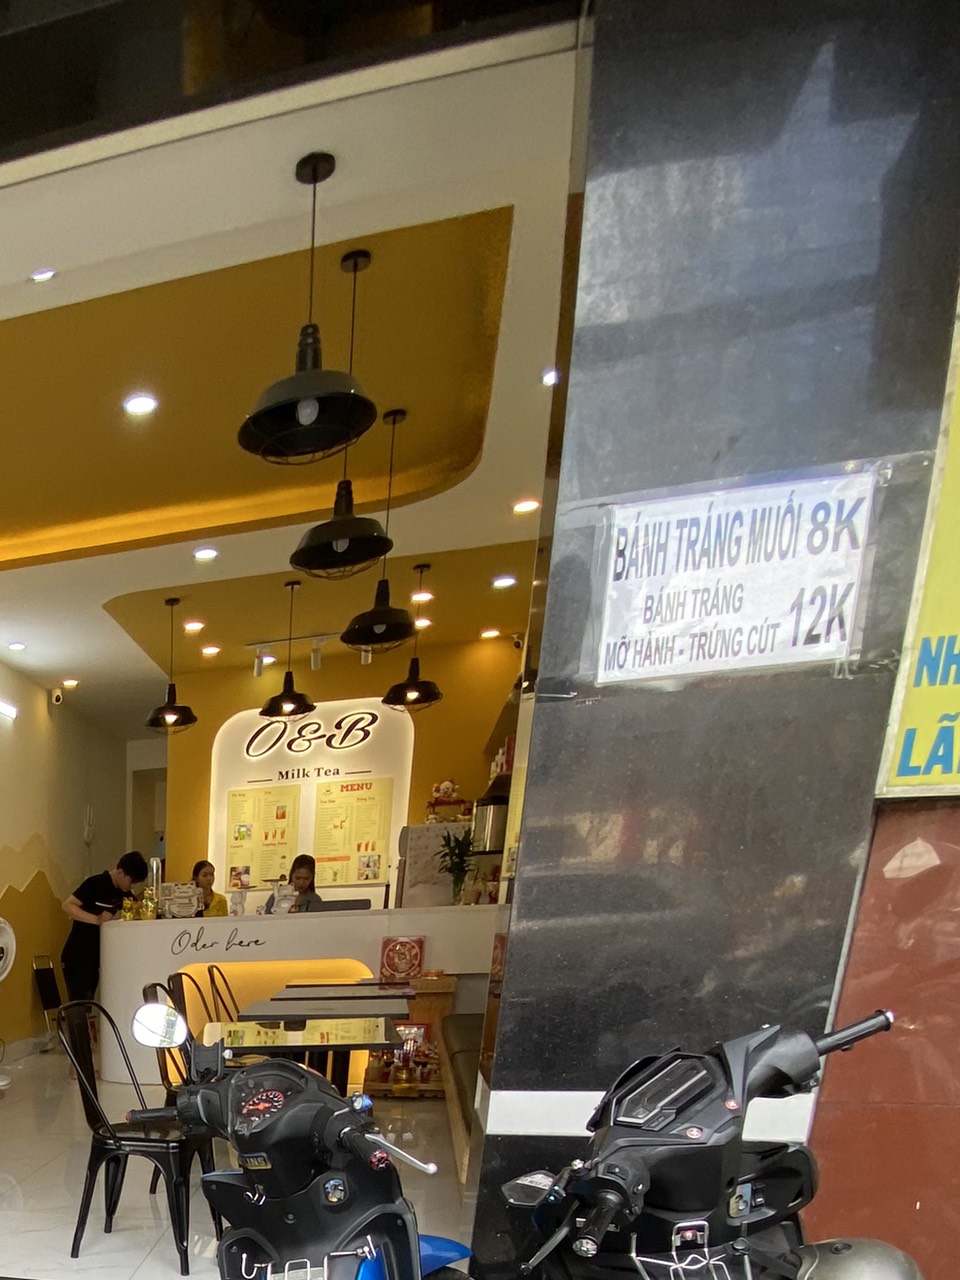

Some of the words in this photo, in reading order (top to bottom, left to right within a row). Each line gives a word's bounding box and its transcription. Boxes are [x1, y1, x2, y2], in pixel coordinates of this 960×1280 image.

[612, 512, 671, 581] BÁNH
[675, 502, 744, 573] TRÁNG
[746, 490, 803, 565] MUỐI
[807, 496, 866, 555] 8K
[643, 586, 688, 624] BÁNH
[691, 579, 744, 618] TRÁNG
[790, 582, 855, 647] 12K
[604, 635, 631, 672] MỠ
[633, 631, 675, 668] HÀNH
[689, 623, 744, 662] TRỨNG
[747, 617, 781, 656] CÚT
[896, 712, 960, 777] LÃ
[277, 769, 310, 781] Milk
[314, 767, 340, 778] Tea
[340, 782, 373, 793] MENU
[171, 927, 218, 955] Oder
[225, 927, 266, 951] here
